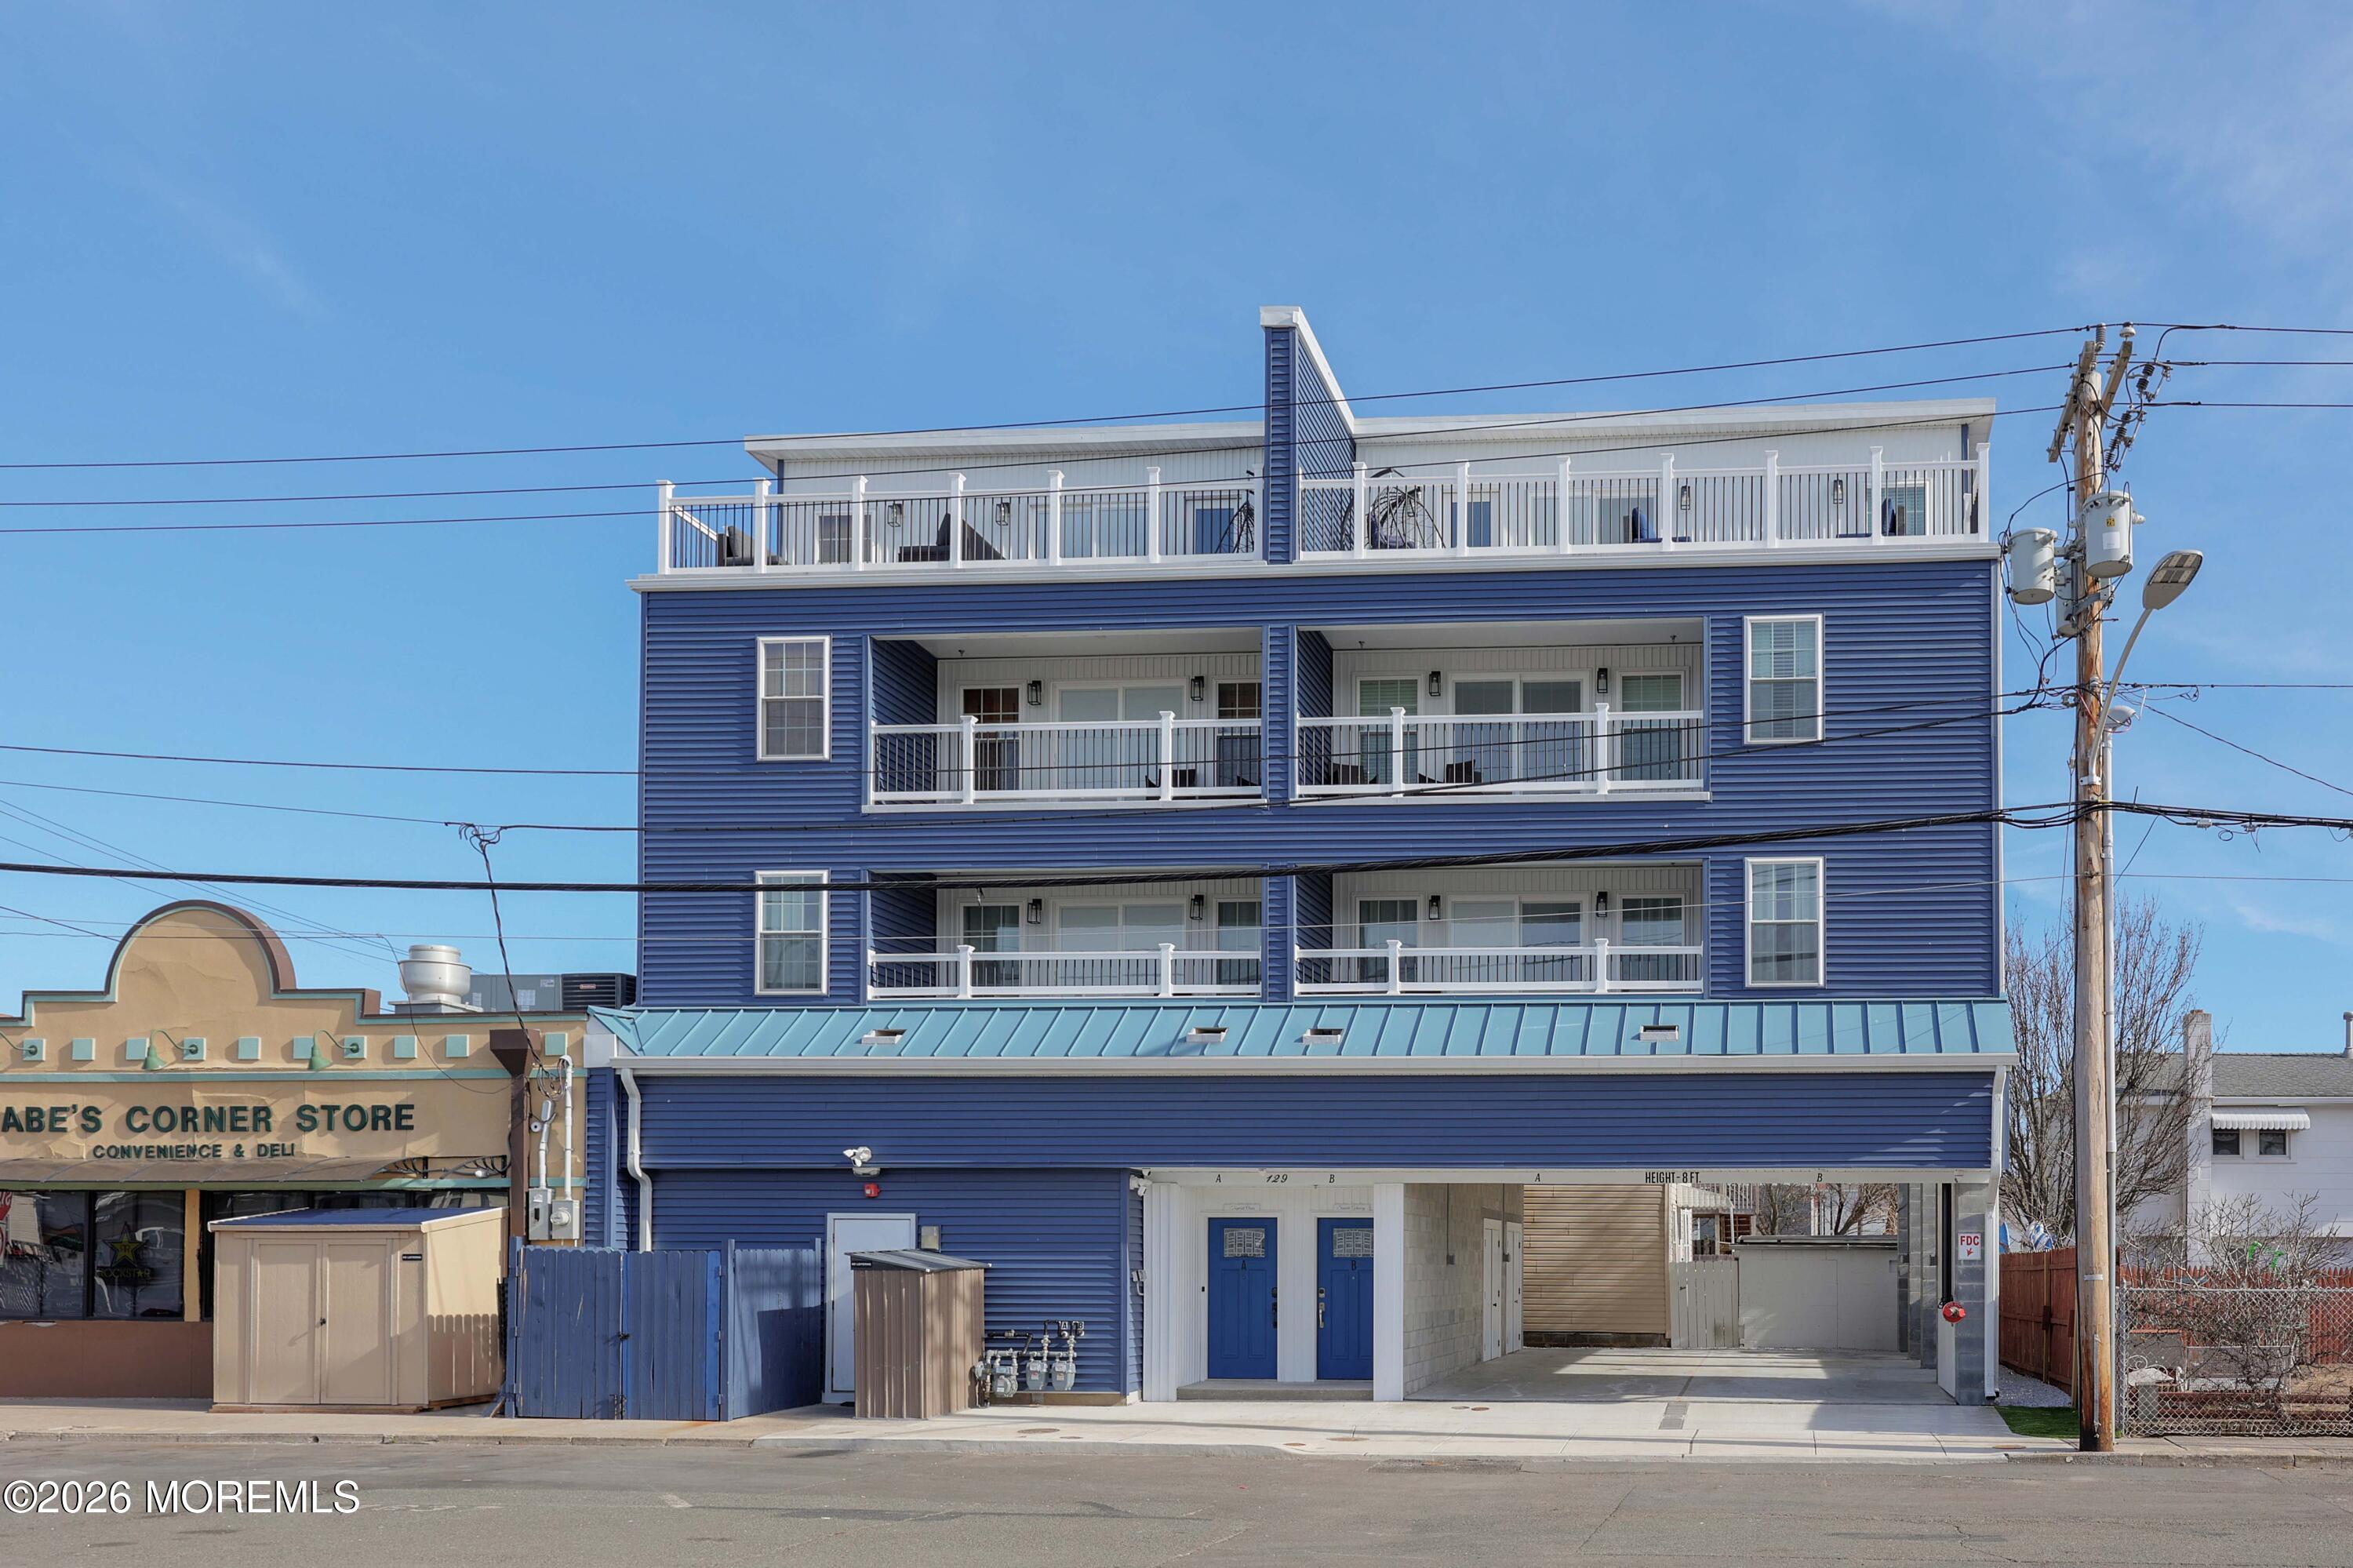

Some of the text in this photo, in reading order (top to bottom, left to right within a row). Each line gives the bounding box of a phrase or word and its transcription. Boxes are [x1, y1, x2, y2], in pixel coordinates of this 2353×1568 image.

[1, 1104, 415, 1133] ABE'S CORNER STORE
[93, 1143, 295, 1159] CONVENIENCE & DELI
[1216, 1173, 1222, 1183] A
[1266, 1173, 1288, 1183] 129
[1329, 1173, 1335, 1184] B
[1534, 1173, 1541, 1182] A
[1682, 1171, 1688, 1184] 8
[1689, 1171, 1701, 1184] FT.
[1817, 1173, 1823, 1182] B
[1960, 1235, 1980, 1246] FDC
